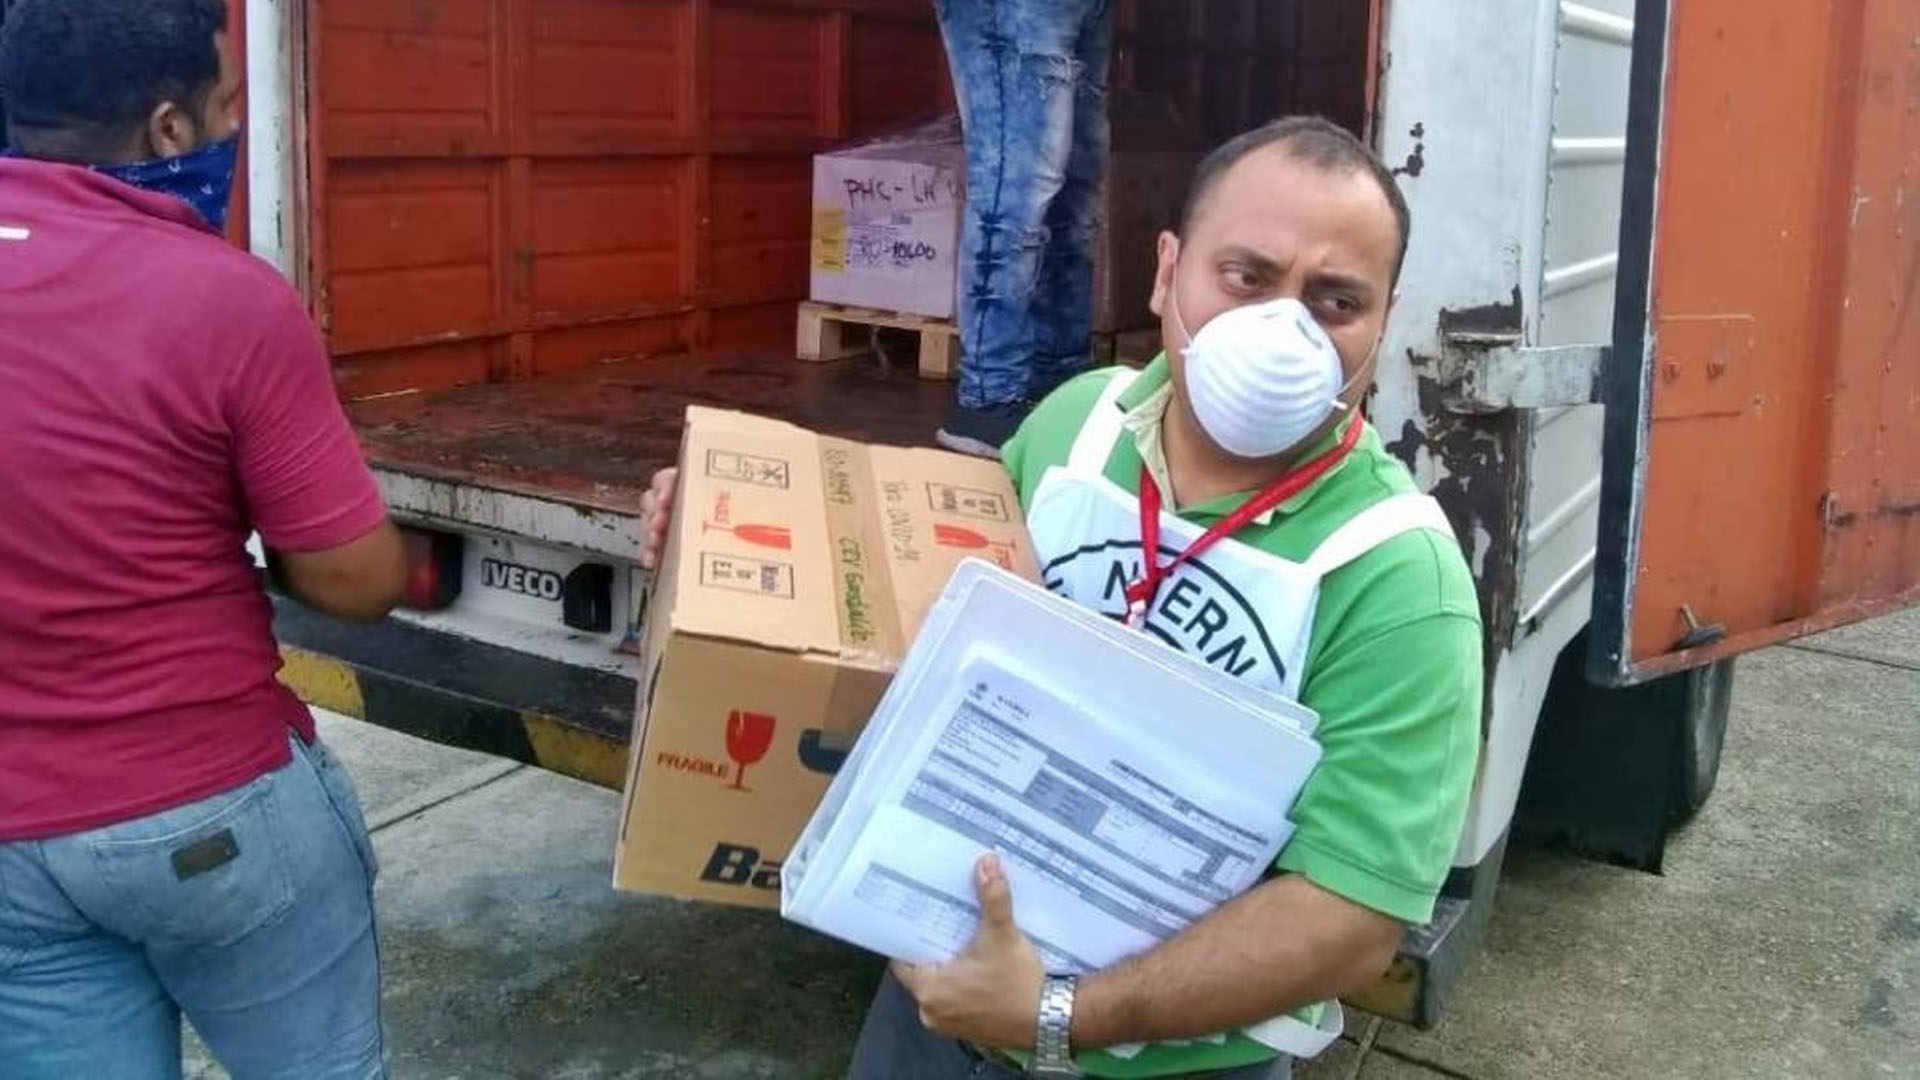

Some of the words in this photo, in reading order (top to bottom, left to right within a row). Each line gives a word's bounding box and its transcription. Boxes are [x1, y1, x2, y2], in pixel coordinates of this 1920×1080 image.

[481, 557, 565, 602] IVECO
[656, 751, 729, 780] FRAGILE
[698, 841, 783, 891] Ba
